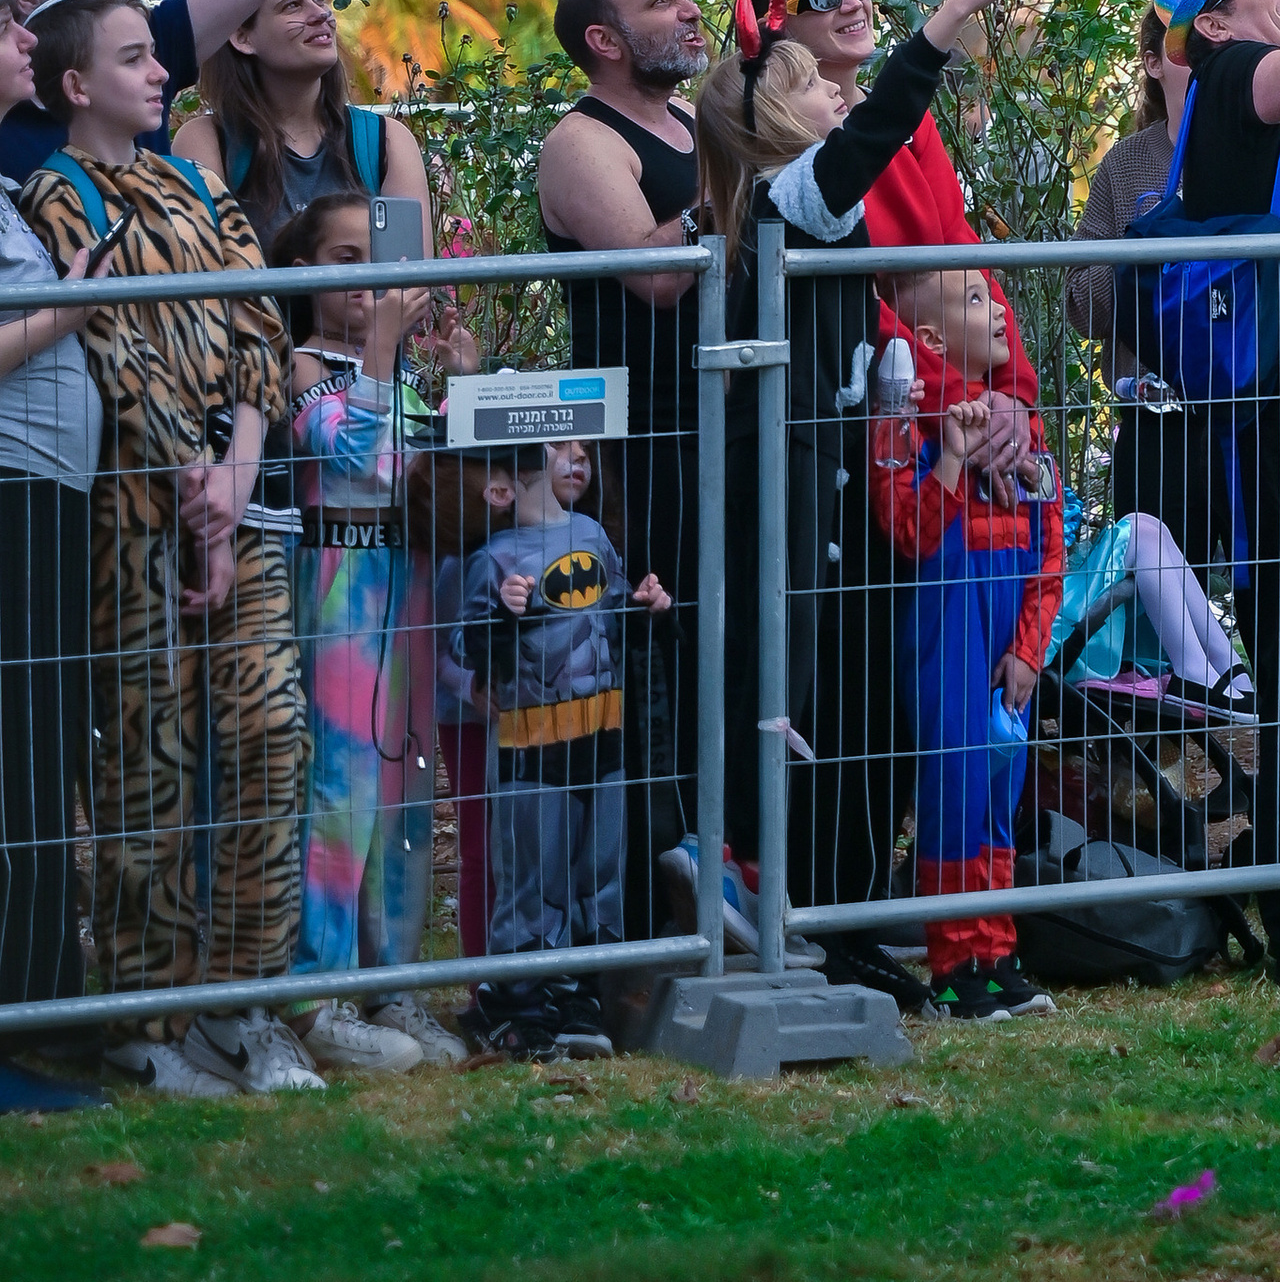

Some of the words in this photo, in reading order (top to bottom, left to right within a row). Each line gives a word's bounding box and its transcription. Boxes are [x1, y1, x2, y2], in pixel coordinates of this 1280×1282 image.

[478, 391, 554, 401] www.out-door.co.il
[508, 411, 546, 423] זמנית
[550, 408, 574, 421] גדר
[508, 424, 534, 433] מכירה
[543, 422, 573, 431] השכרה
[332, 524, 385, 547] LOVE
